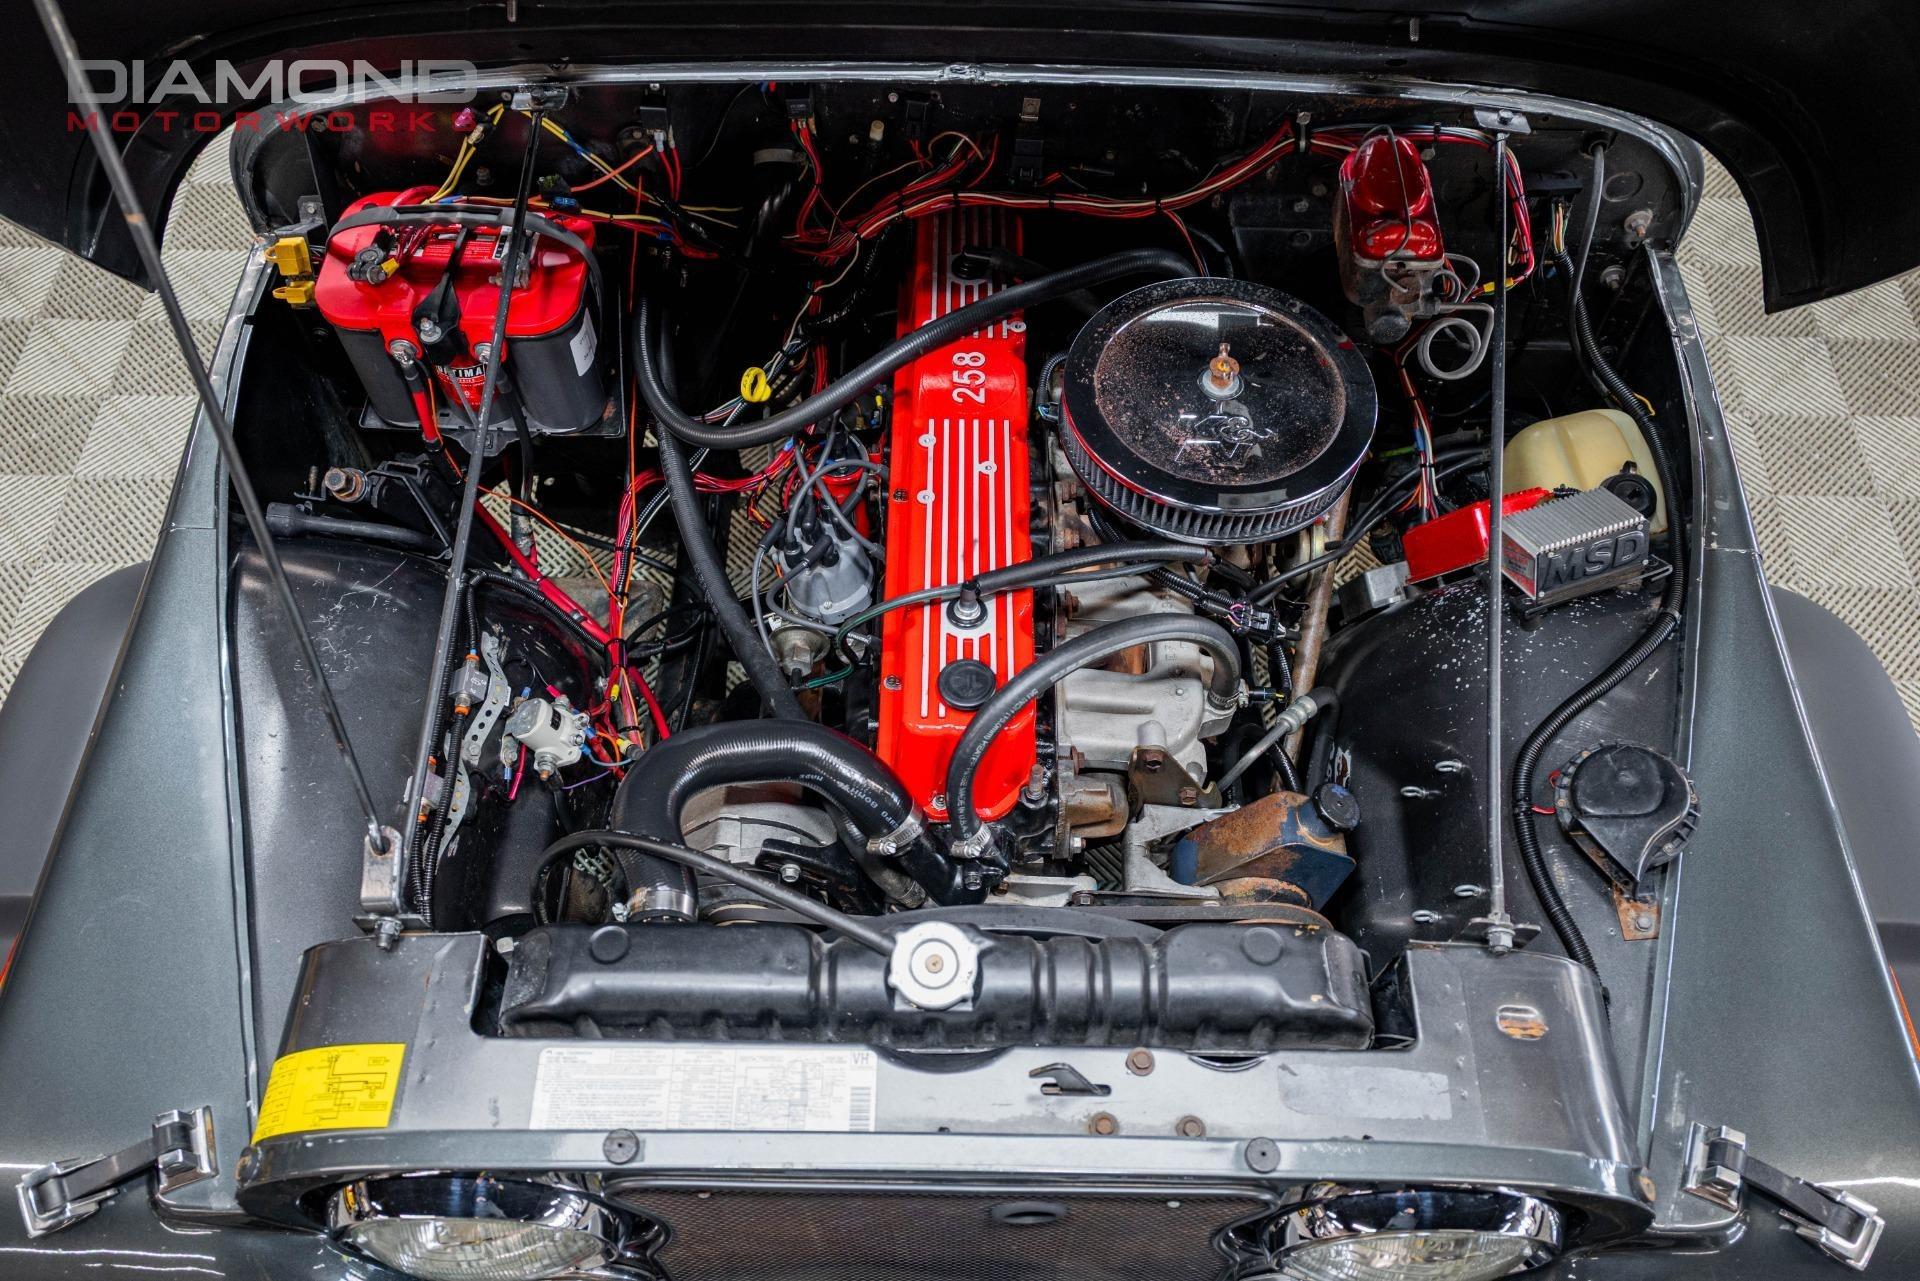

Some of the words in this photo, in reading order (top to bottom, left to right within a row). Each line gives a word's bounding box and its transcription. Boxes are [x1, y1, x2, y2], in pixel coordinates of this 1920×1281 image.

[952, 351, 986, 405] 258
[1541, 530, 1646, 590] MSD
[853, 1053, 869, 1064] VH
